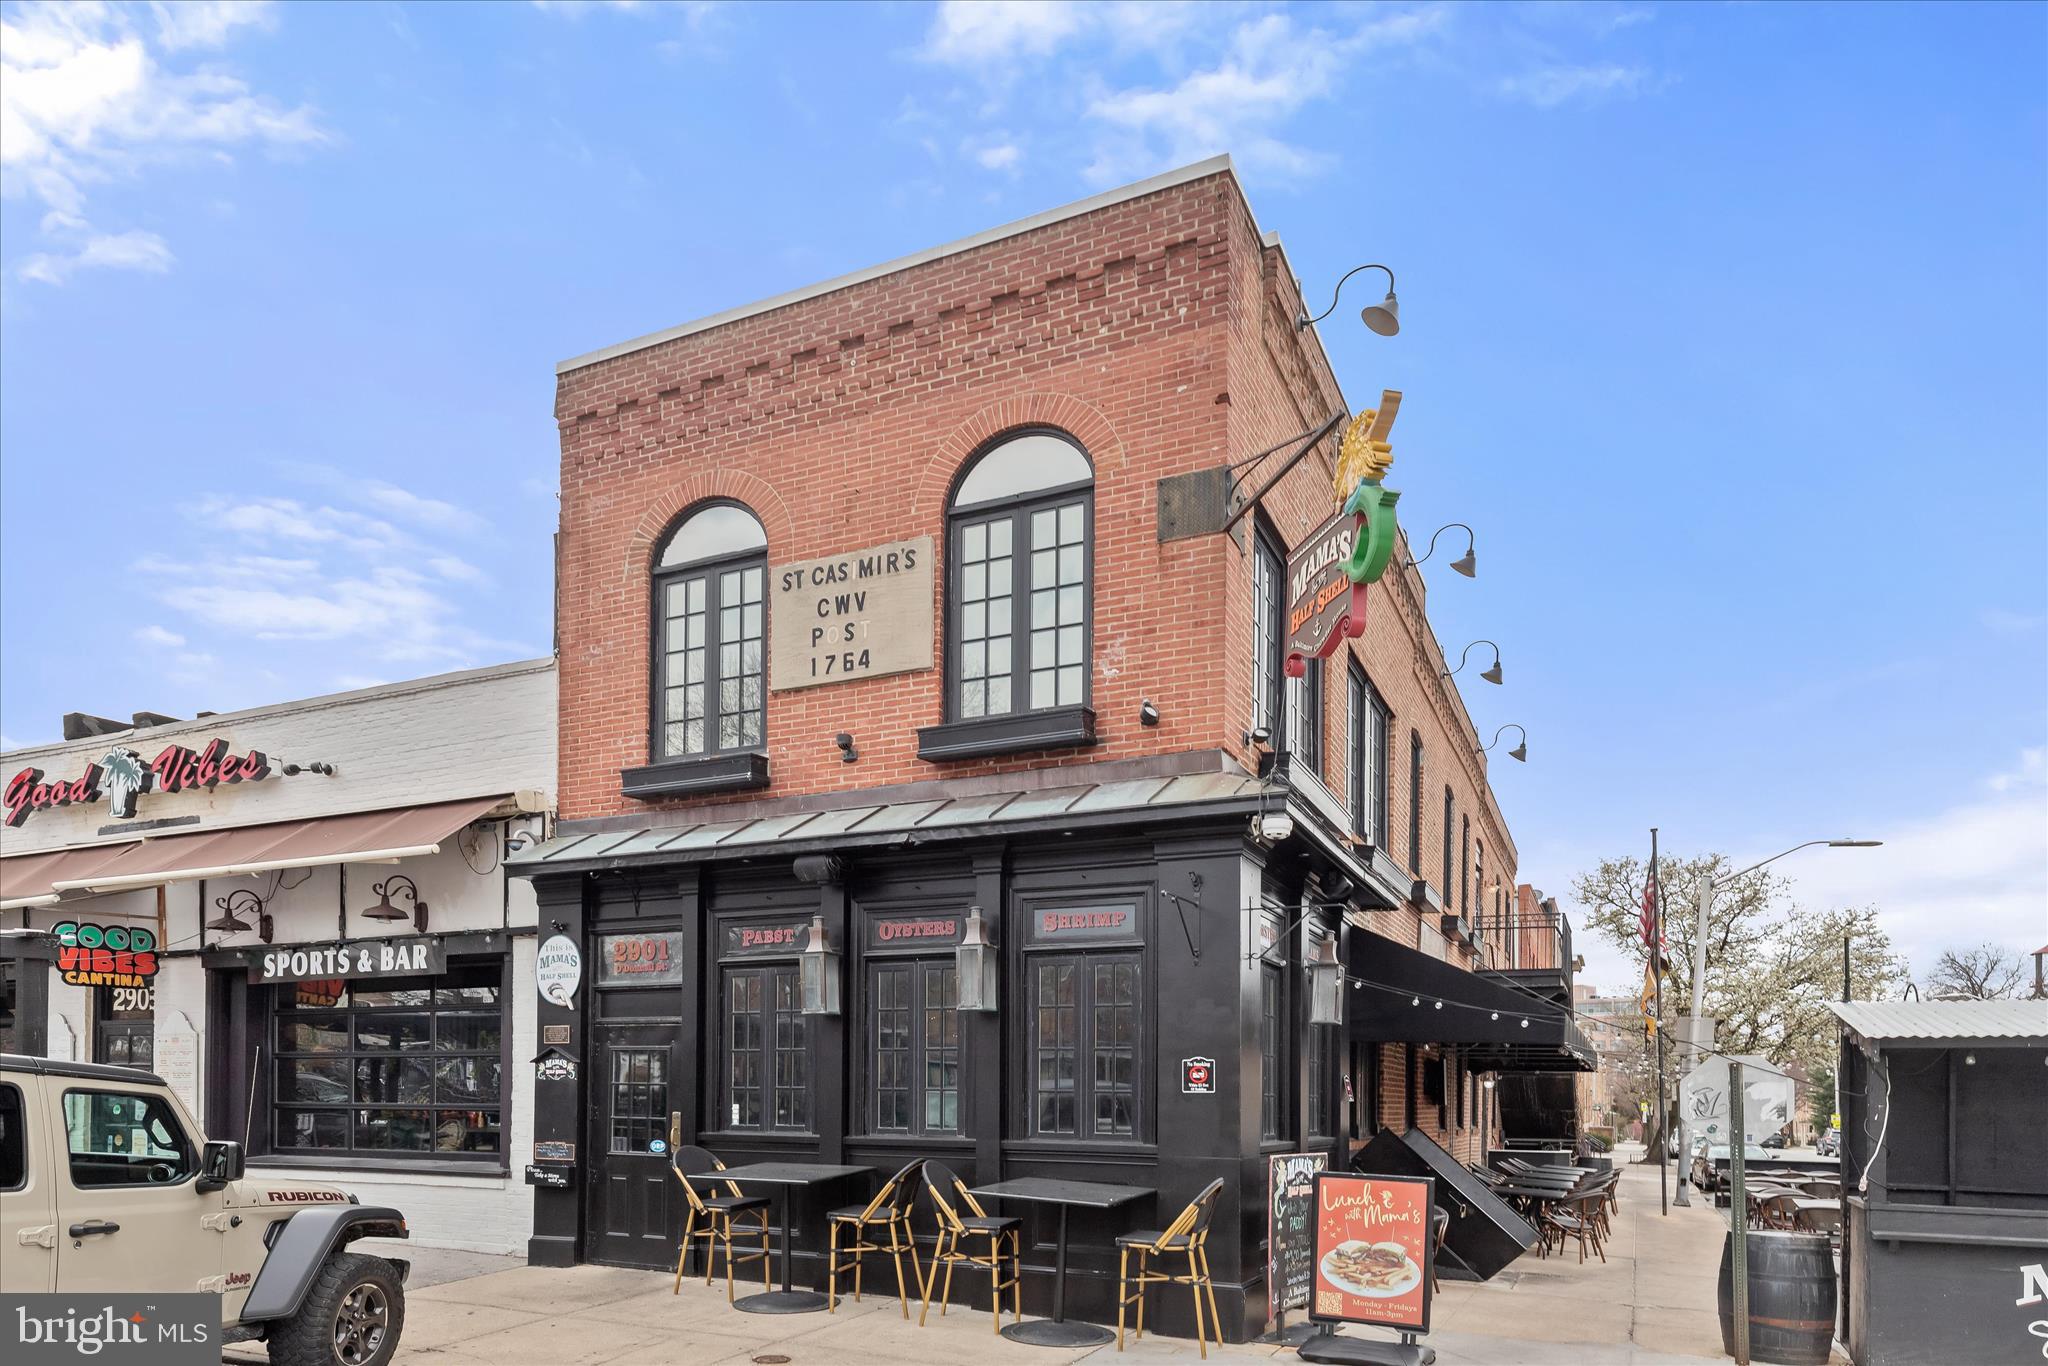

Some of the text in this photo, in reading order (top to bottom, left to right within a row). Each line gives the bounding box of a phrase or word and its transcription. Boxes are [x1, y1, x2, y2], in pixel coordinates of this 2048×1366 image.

[782, 548, 917, 592] ST CASIMIR'S
[1290, 529, 1353, 609] MAMA'S
[817, 591, 867, 618] CWV
[1290, 599, 1316, 636] HALF
[1316, 573, 1350, 615] SHELL
[811, 649, 871, 677] 1764
[3, 737, 266, 828] Good Vibes
[879, 920, 956, 941] OYSTERS
[1043, 911, 1127, 933] SHRIMP
[54, 923, 154, 952] GOOD
[742, 928, 795, 947] PABST
[58, 947, 157, 975] VIBES
[263, 944, 428, 978] SPORTS & BAR
[540, 953, 577, 969] MAMA'S
[613, 939, 669, 963] 2901
[65, 971, 145, 987] CANTINA
[540, 972, 576, 981] HALF SHELL
[545, 1059, 568, 1068] MAMA'S
[1287, 1157, 1314, 1181] MAMA'S
[267, 1191, 345, 1202] RUBICON
[1323, 1182, 1375, 1211] Lunch
[1344, 1201, 1421, 1229] with Mama's
[225, 1272, 251, 1286] Jeep
[1352, 1299, 1382, 1310] Monday
[1388, 1302, 1417, 1312] Fridays
[1365, 1308, 1404, 1319] 11am-3pm
